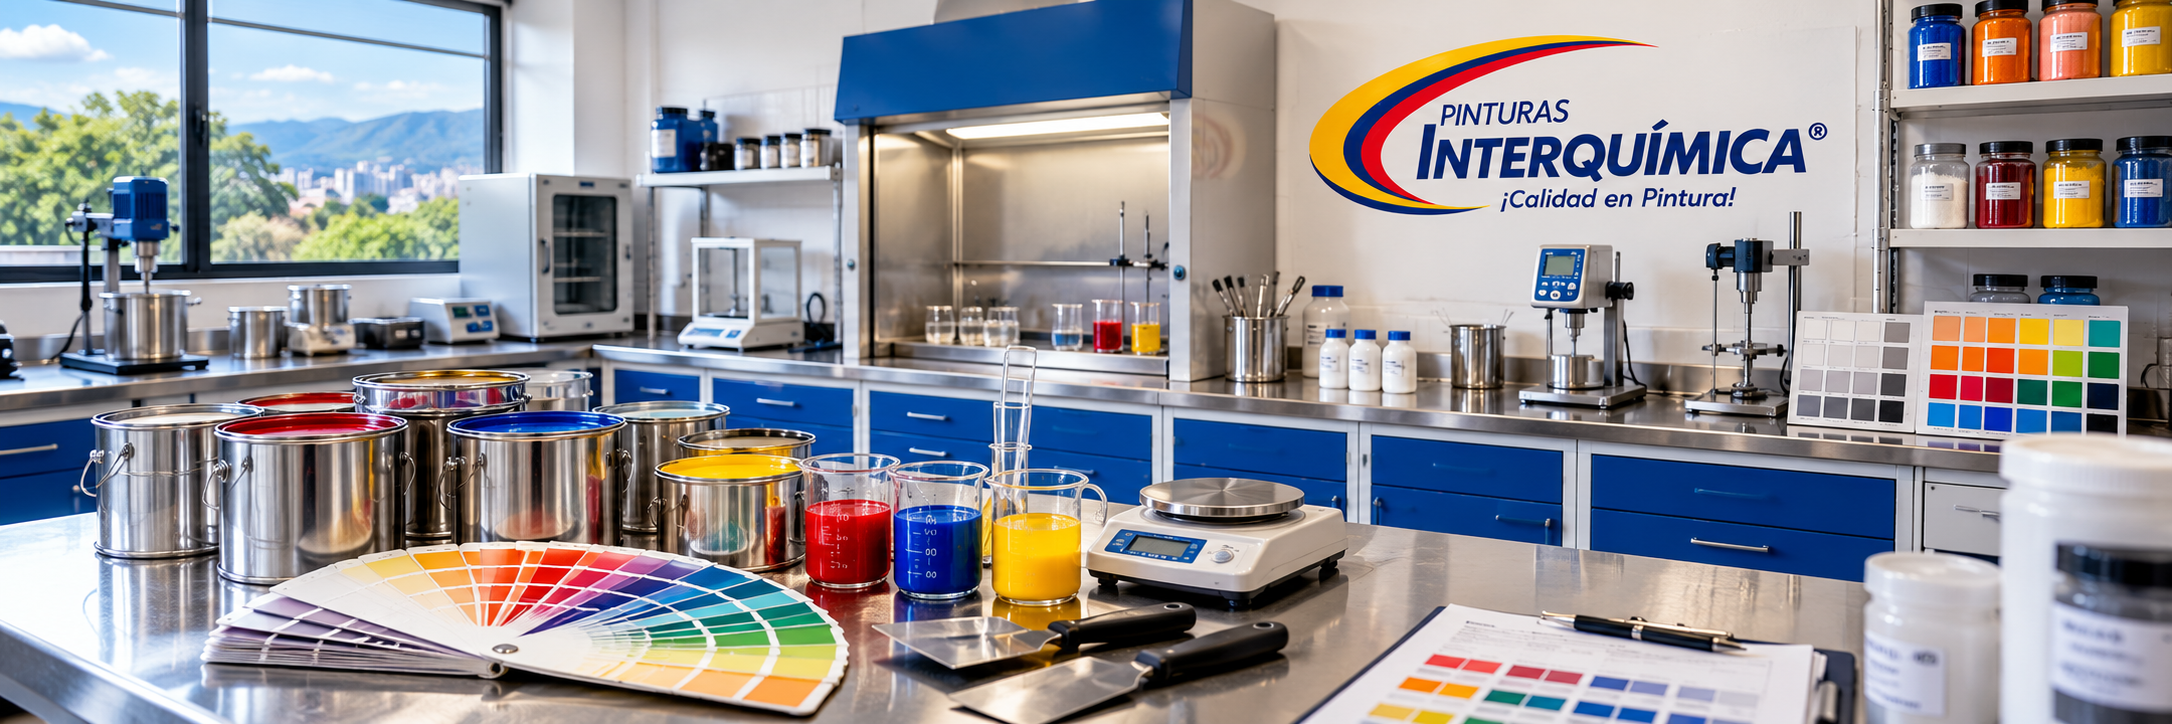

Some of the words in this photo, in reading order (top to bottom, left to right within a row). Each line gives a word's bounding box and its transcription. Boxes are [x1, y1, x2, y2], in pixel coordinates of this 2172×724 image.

[1440, 99, 1570, 126] PINTURAS
[1500, 187, 1598, 213] ¡Calidad
[1604, 193, 1633, 208] en
[1641, 187, 1737, 208] Pintura!
